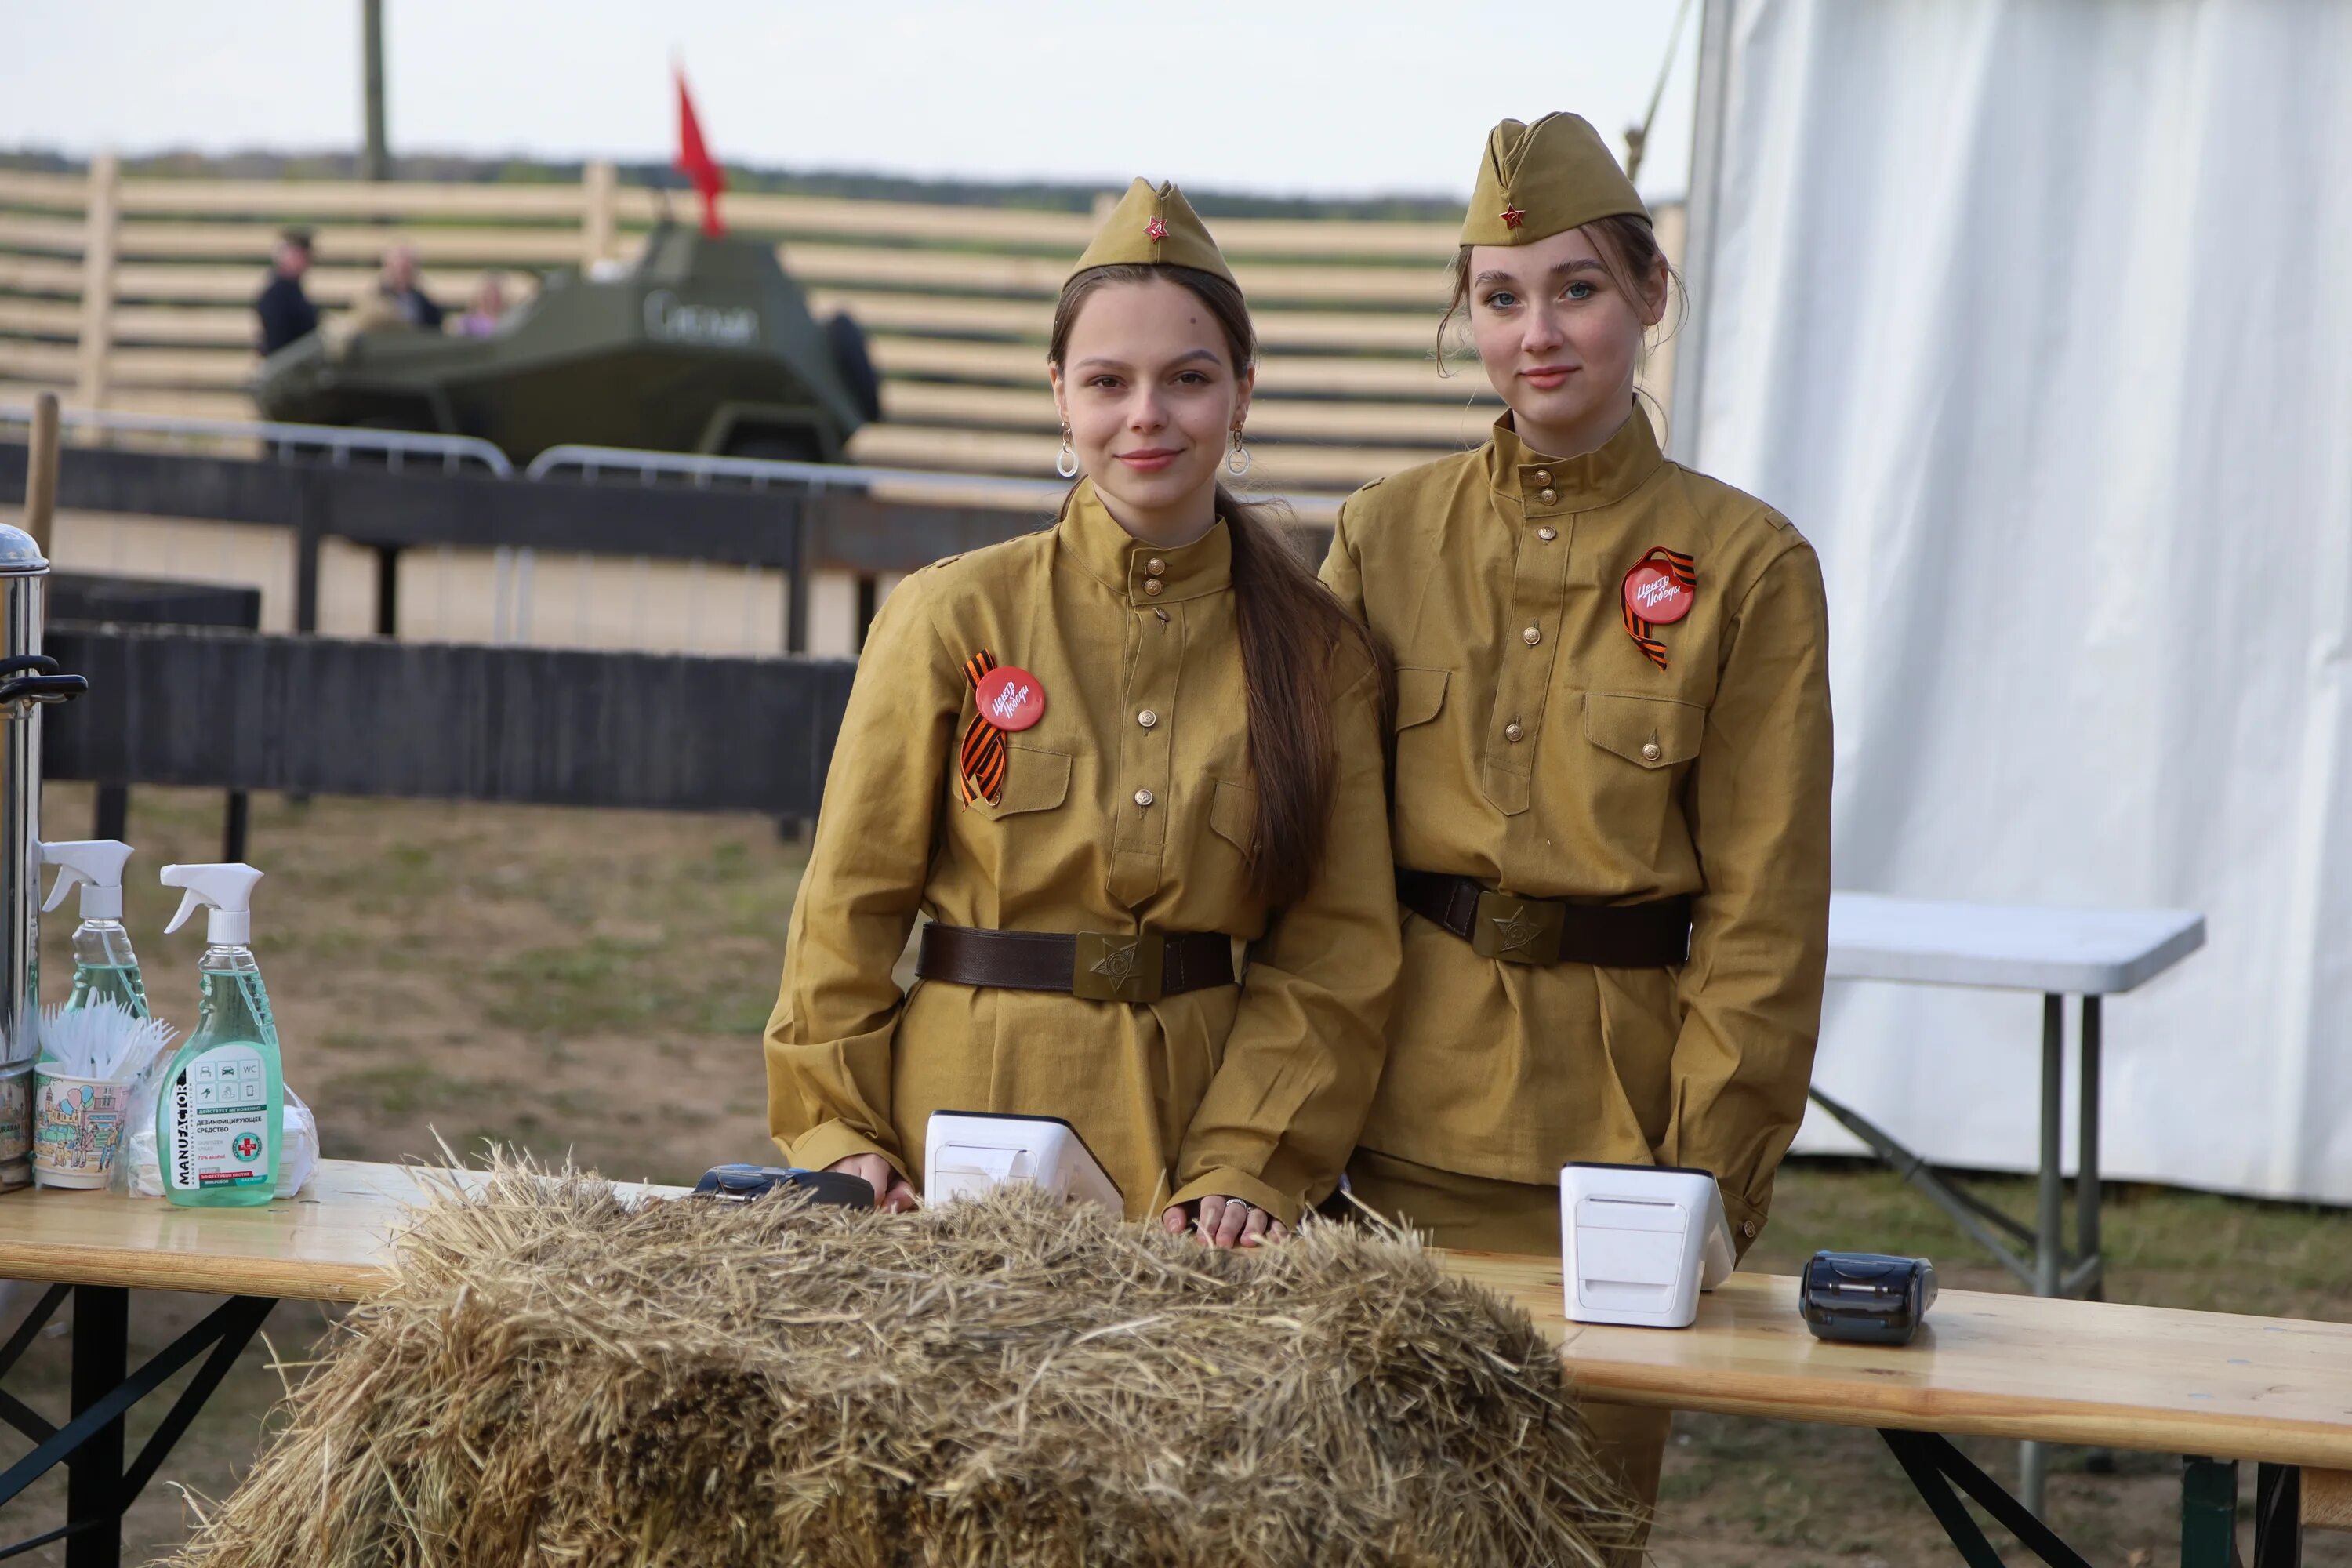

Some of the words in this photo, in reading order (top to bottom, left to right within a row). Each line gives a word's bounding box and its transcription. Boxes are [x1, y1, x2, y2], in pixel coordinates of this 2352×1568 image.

[1637, 575, 1670, 601] Центр
[1646, 585, 1681, 608] Победы
[992, 681, 1015, 716] Центр
[1004, 684, 1029, 719] Победы
[176, 1084, 190, 1185] MANUFACTOR
[196, 1116, 262, 1126] ДЕЗИНФИЦИРУЮЩЕЕ
